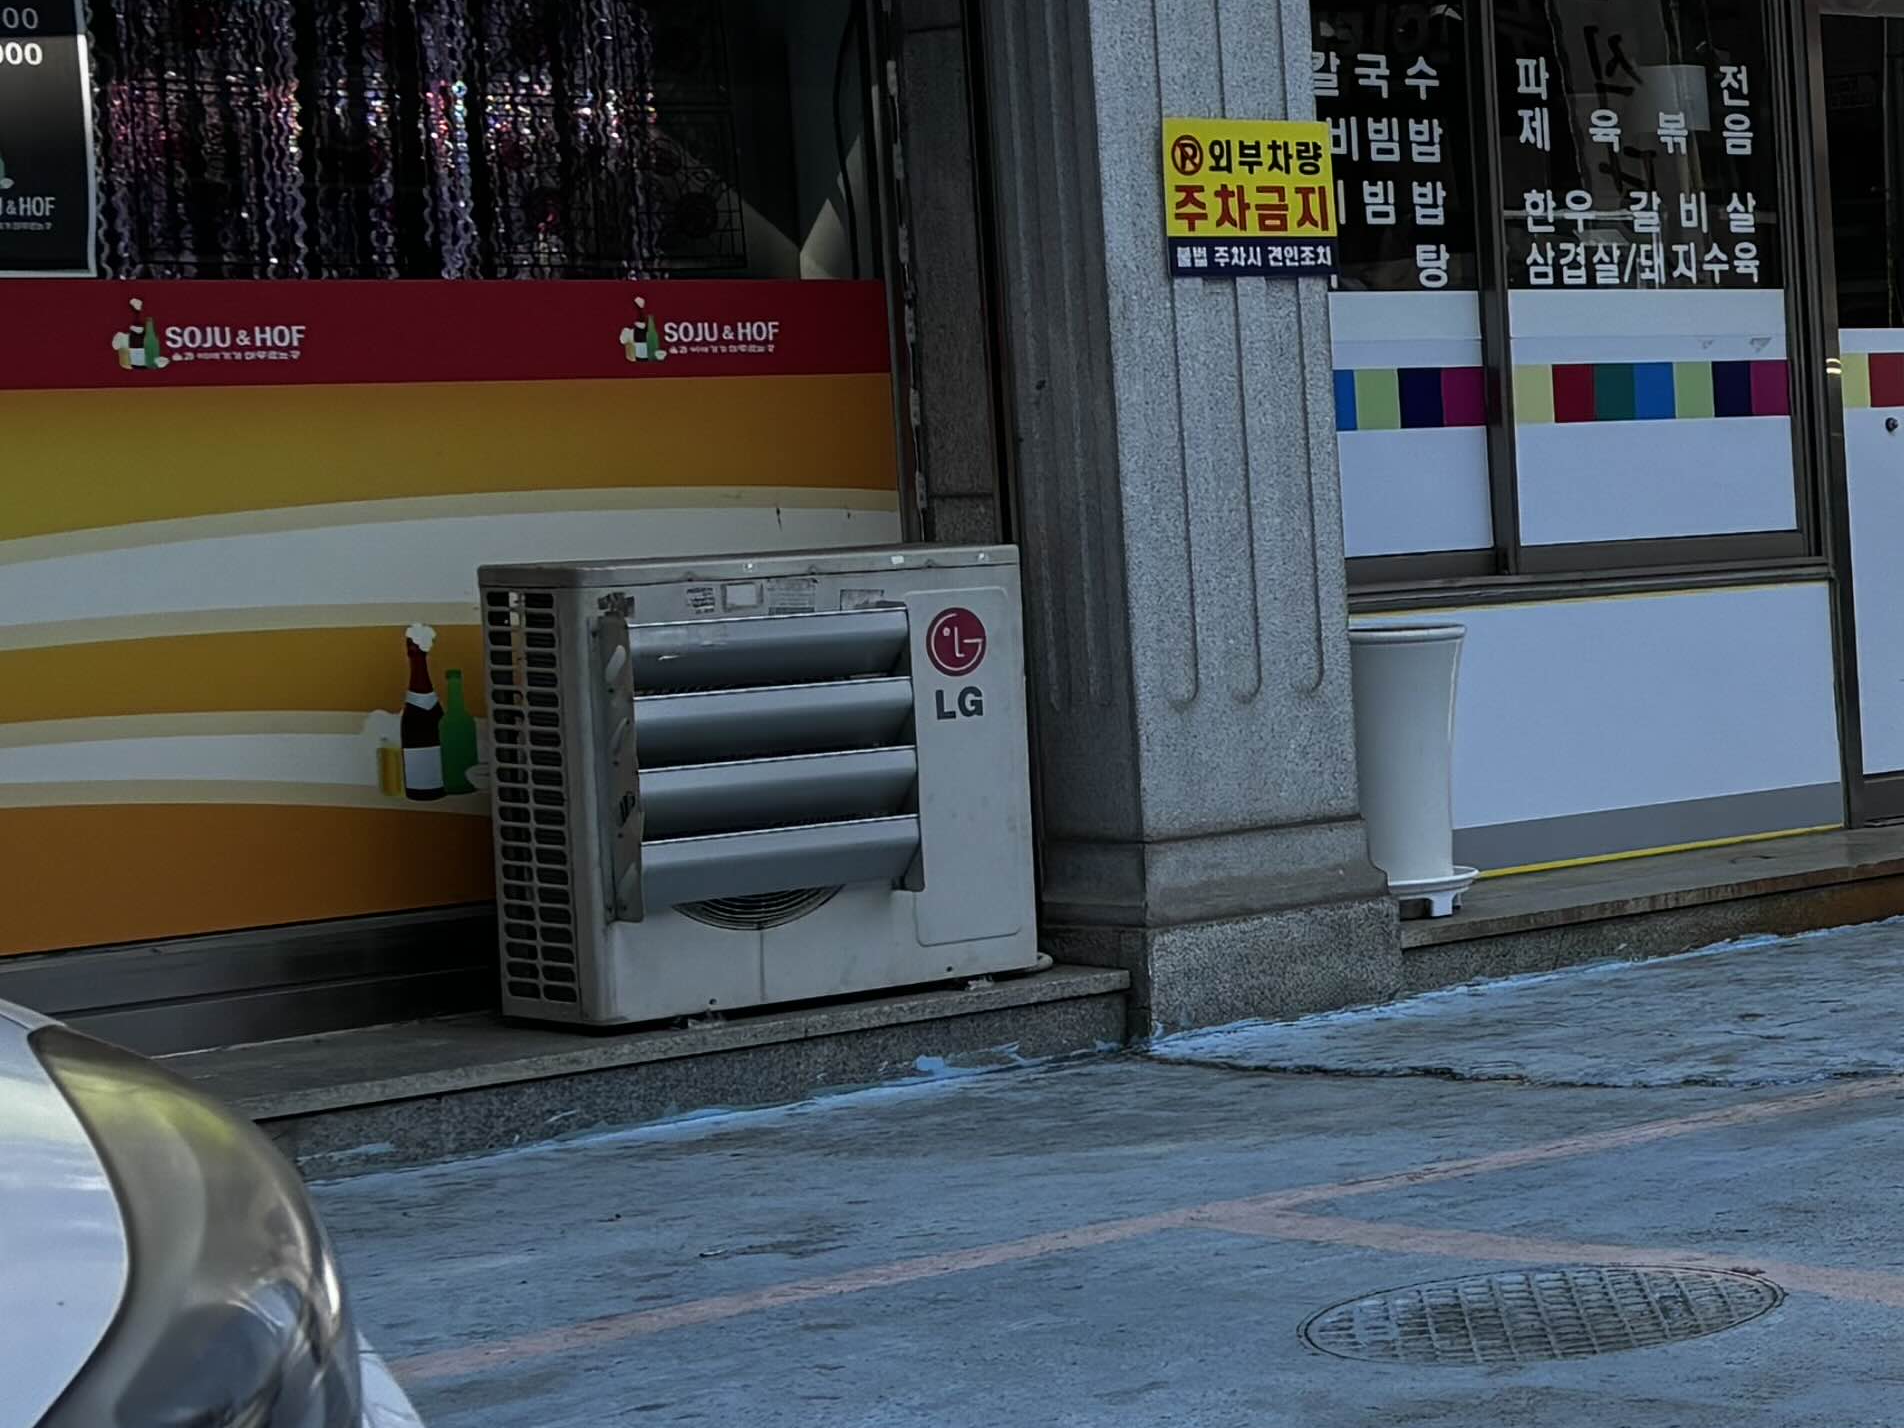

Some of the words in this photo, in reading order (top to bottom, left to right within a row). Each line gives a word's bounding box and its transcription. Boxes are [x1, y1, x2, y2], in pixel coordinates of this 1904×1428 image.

[1311, 51, 1441, 100] 칼국수
[1208, 139, 1323, 176] 외부차량
[19, 196, 56, 217] HOF
[1174, 184, 1330, 232] 주차금지
[1336, 179, 1447, 225] 빔밥
[1523, 188, 1597, 233] 한우
[1214, 245, 1262, 267] 주차시
[1267, 245, 1332, 267] 견인조치
[1526, 241, 1760, 285] 삼겹살/돼지수육
[165, 325, 231, 348] SOJU
[236, 329, 250, 347] &
[254, 325, 306, 348] HOF
[664, 322, 718, 343] SOJU
[722, 324, 735, 341] &
[737, 321, 780, 342] HOF
[934, 685, 984, 721] LG
